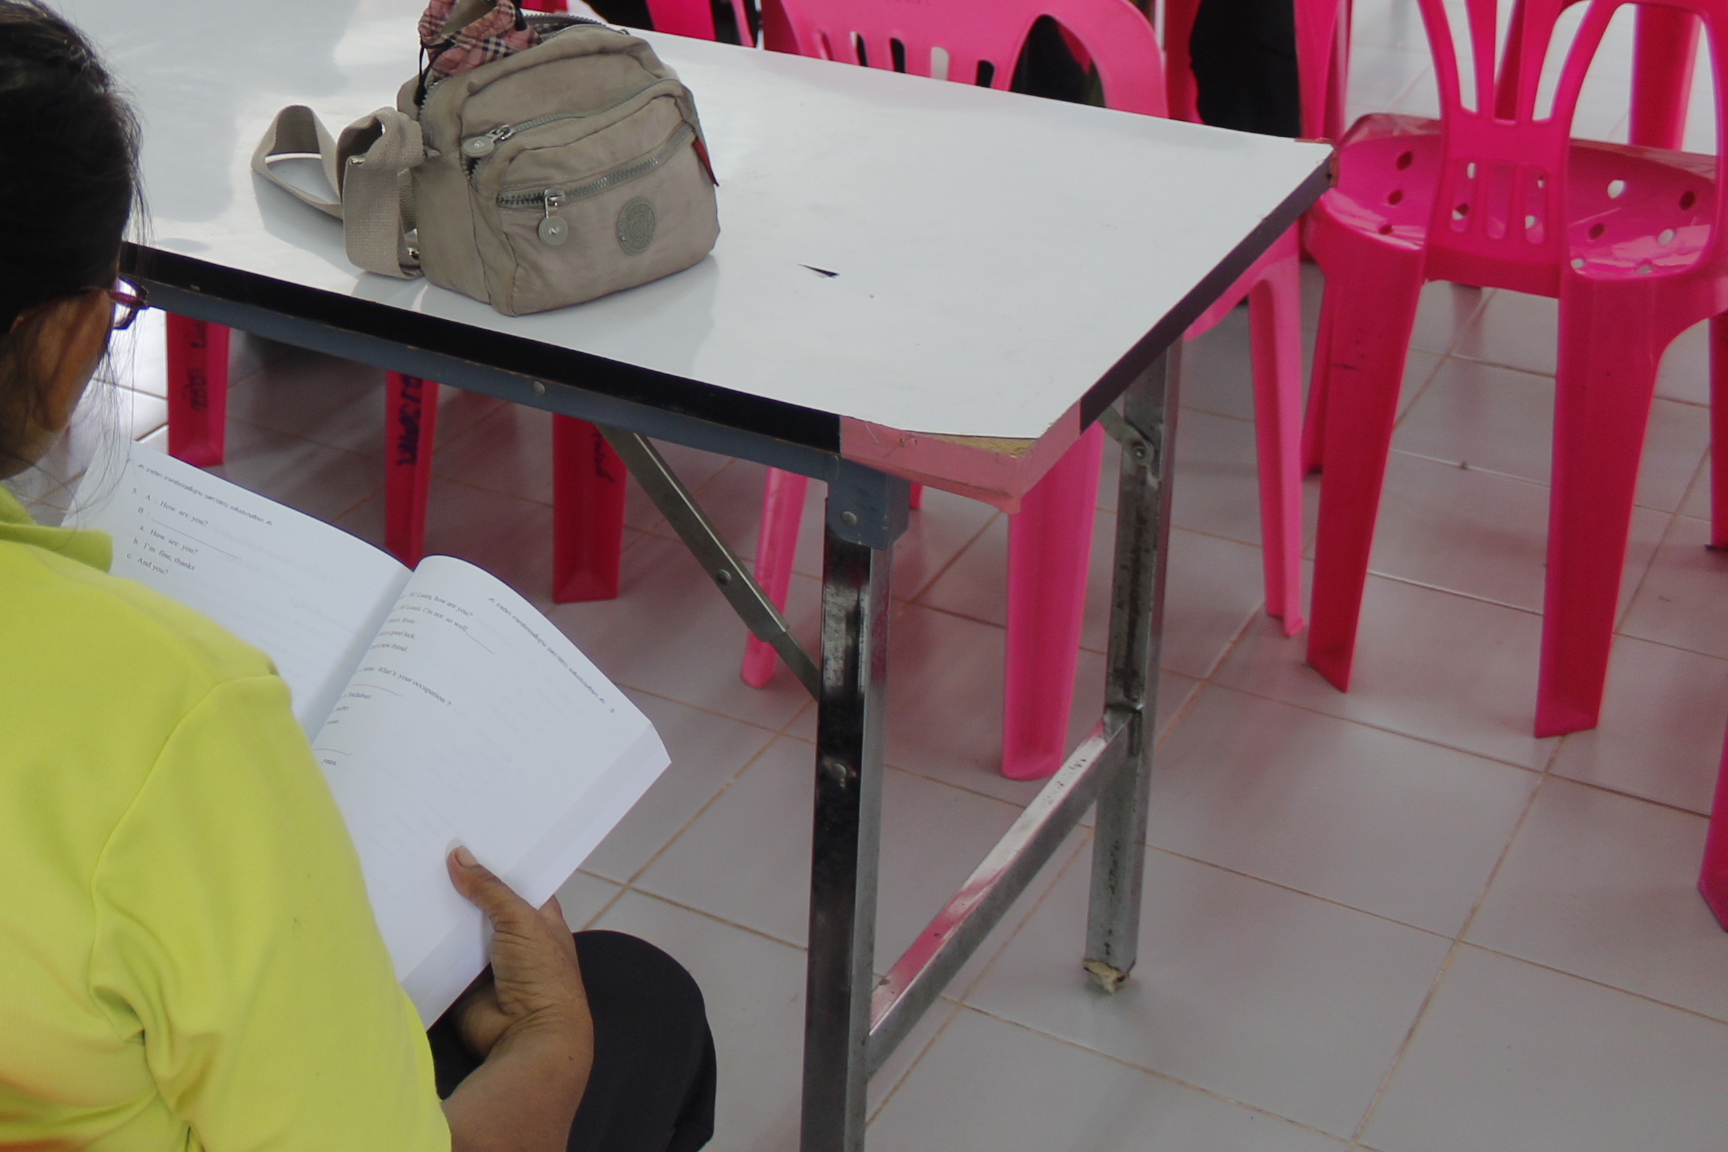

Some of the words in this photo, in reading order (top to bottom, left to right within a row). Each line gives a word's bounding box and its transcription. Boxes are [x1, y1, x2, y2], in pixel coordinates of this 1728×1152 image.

[160, 500, 176, 512] How
[178, 509, 190, 519] are
[191, 515, 209, 527] you?
[150, 528, 166, 541] How
[168, 537, 179, 547] are
[182, 544, 199, 556] you?
[137, 557, 152, 569] And
[152, 564, 170, 576] you?
[143, 542, 156, 554] I'm
[158, 549, 173, 562] fine,
[174, 557, 196, 572] thanks
[446, 601, 457, 609] are
[456, 606, 473, 618] you?
[396, 674, 413, 683] your
[412, 680, 446, 704] occupation
